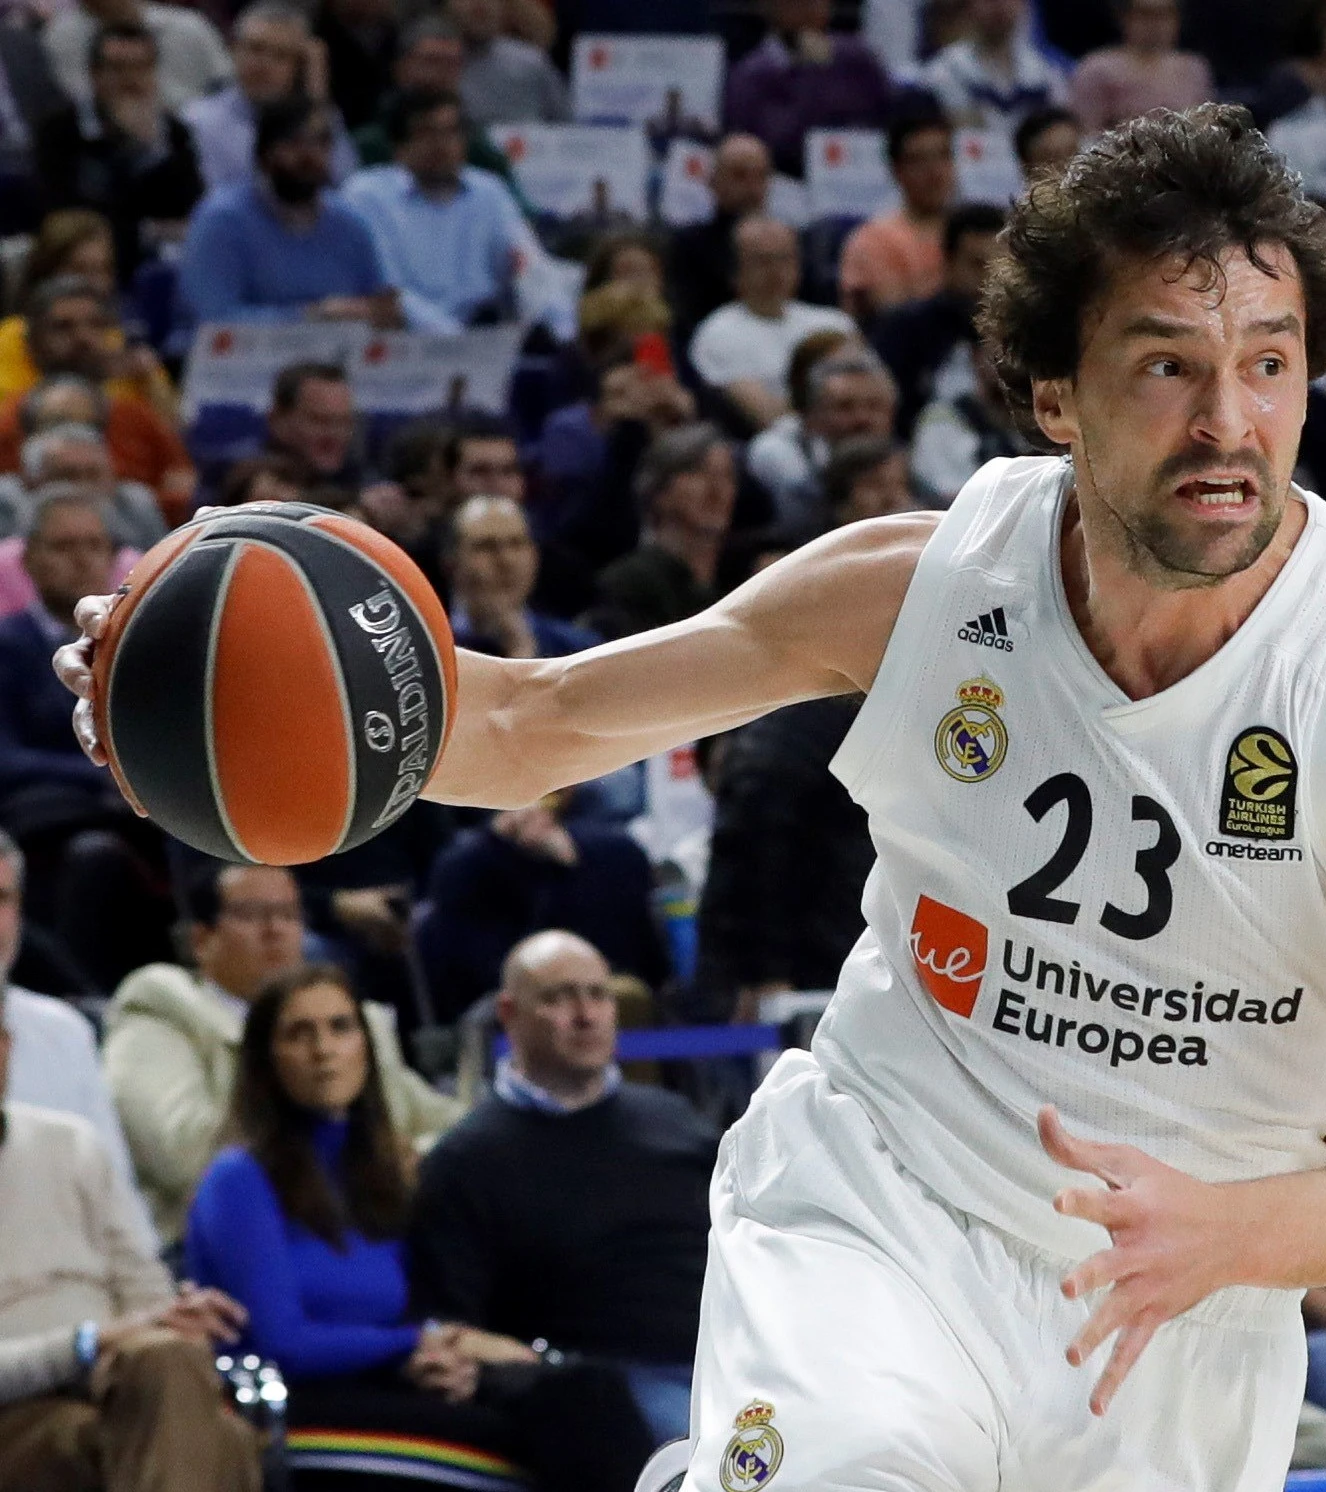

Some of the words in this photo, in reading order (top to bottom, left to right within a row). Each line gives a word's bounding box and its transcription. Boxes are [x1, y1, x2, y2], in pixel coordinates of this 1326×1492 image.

[957, 628, 1014, 653] adidas
[1227, 809, 1286, 826] AIRLINES
[1228, 798, 1286, 815] TURKISH
[1226, 820, 1286, 836] EuroLeague
[1007, 772, 1182, 941] 23
[1205, 841, 1303, 862] oneteam
[1003, 940, 1304, 1025] Universidad
[992, 989, 1208, 1068] Europea
